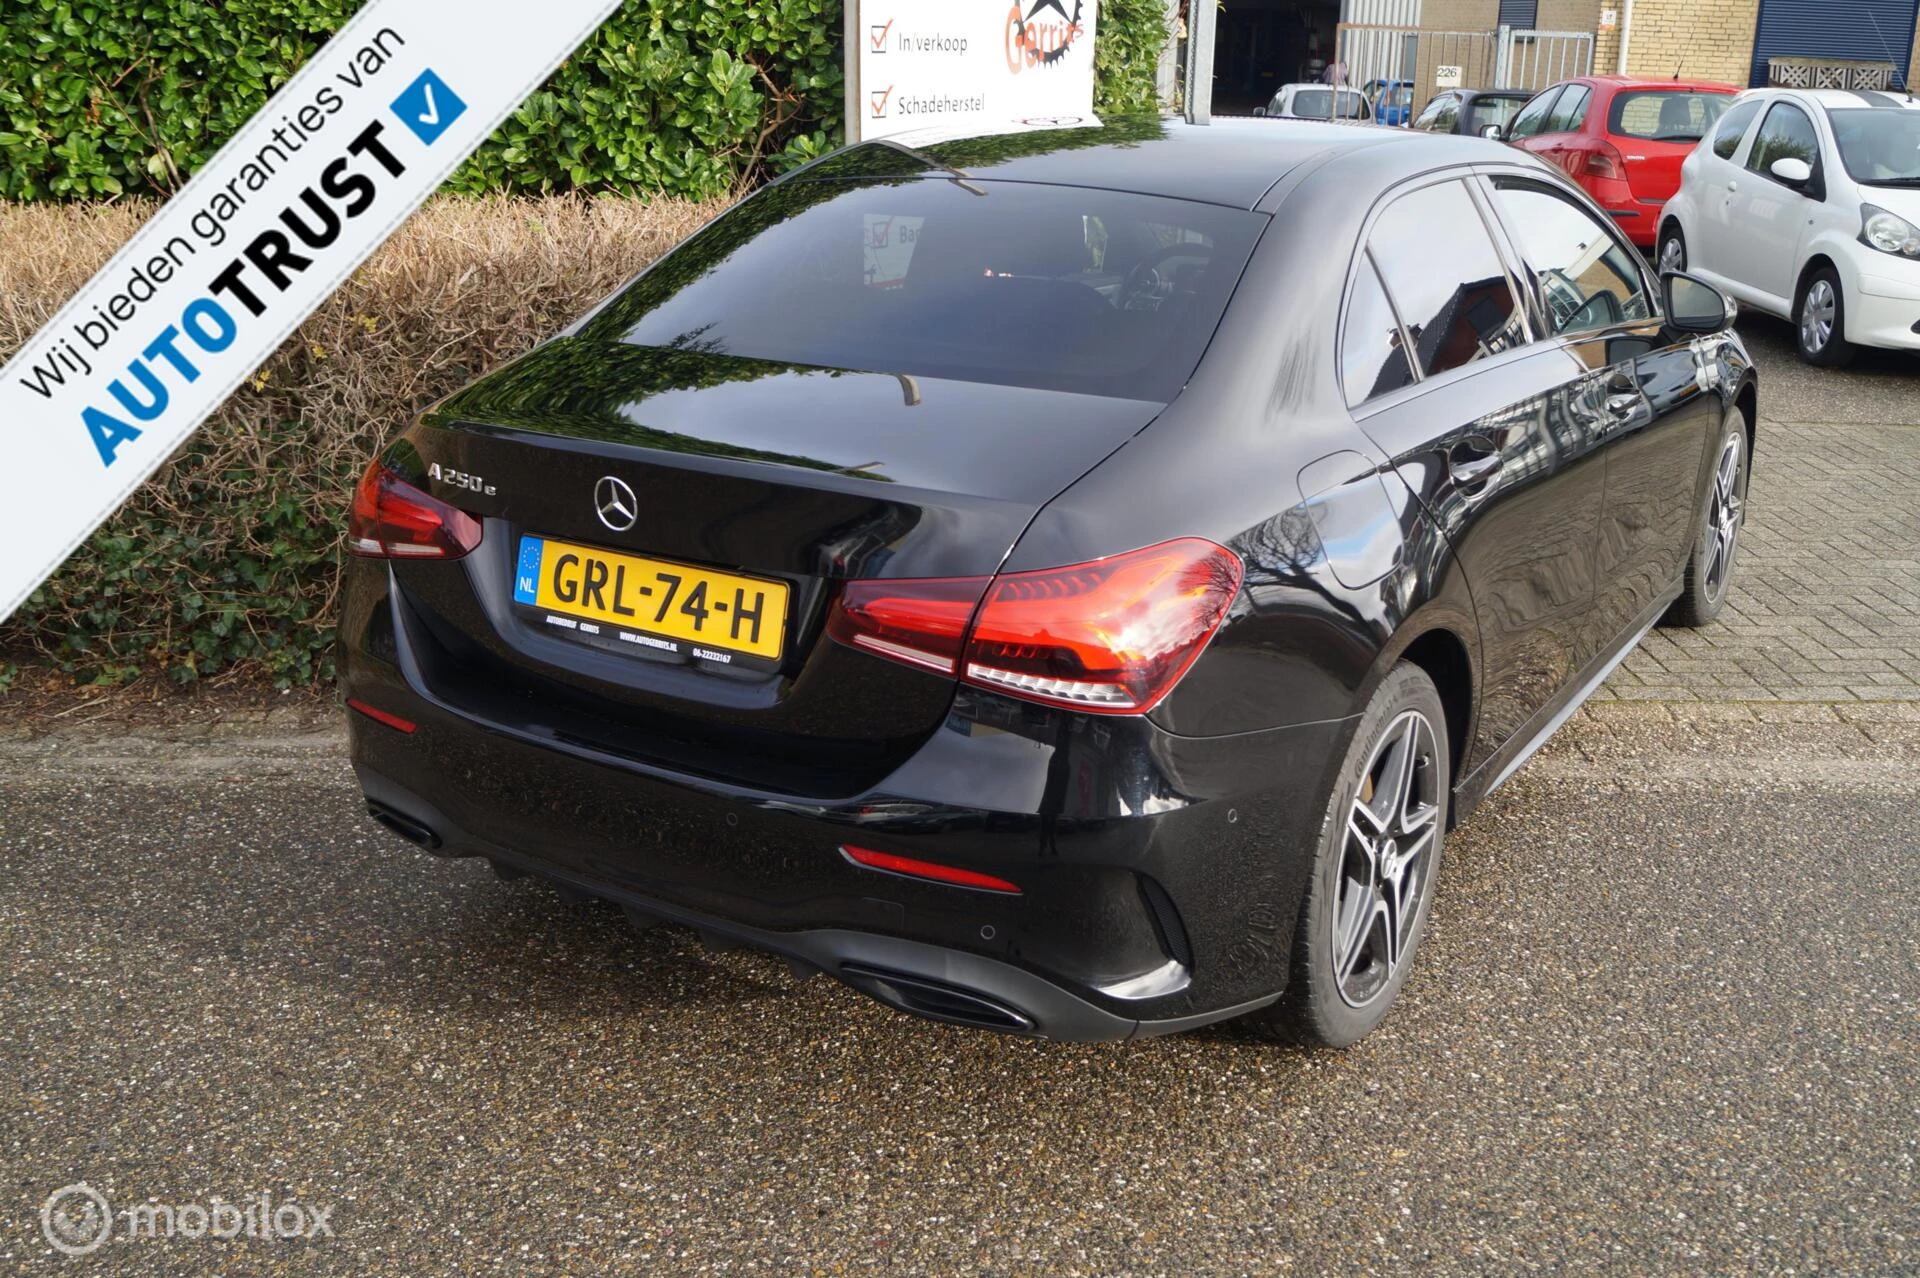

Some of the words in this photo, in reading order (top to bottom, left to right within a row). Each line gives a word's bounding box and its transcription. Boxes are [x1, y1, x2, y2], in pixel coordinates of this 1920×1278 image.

[899, 32, 968, 56] In/verkoop
[1005, 5, 1084, 75] Gerrits
[1437, 67, 1457, 78] 226
[899, 92, 985, 115] Schadeherstel
[519, 576, 535, 594] NL
[553, 553, 765, 644] GRL-74-H
